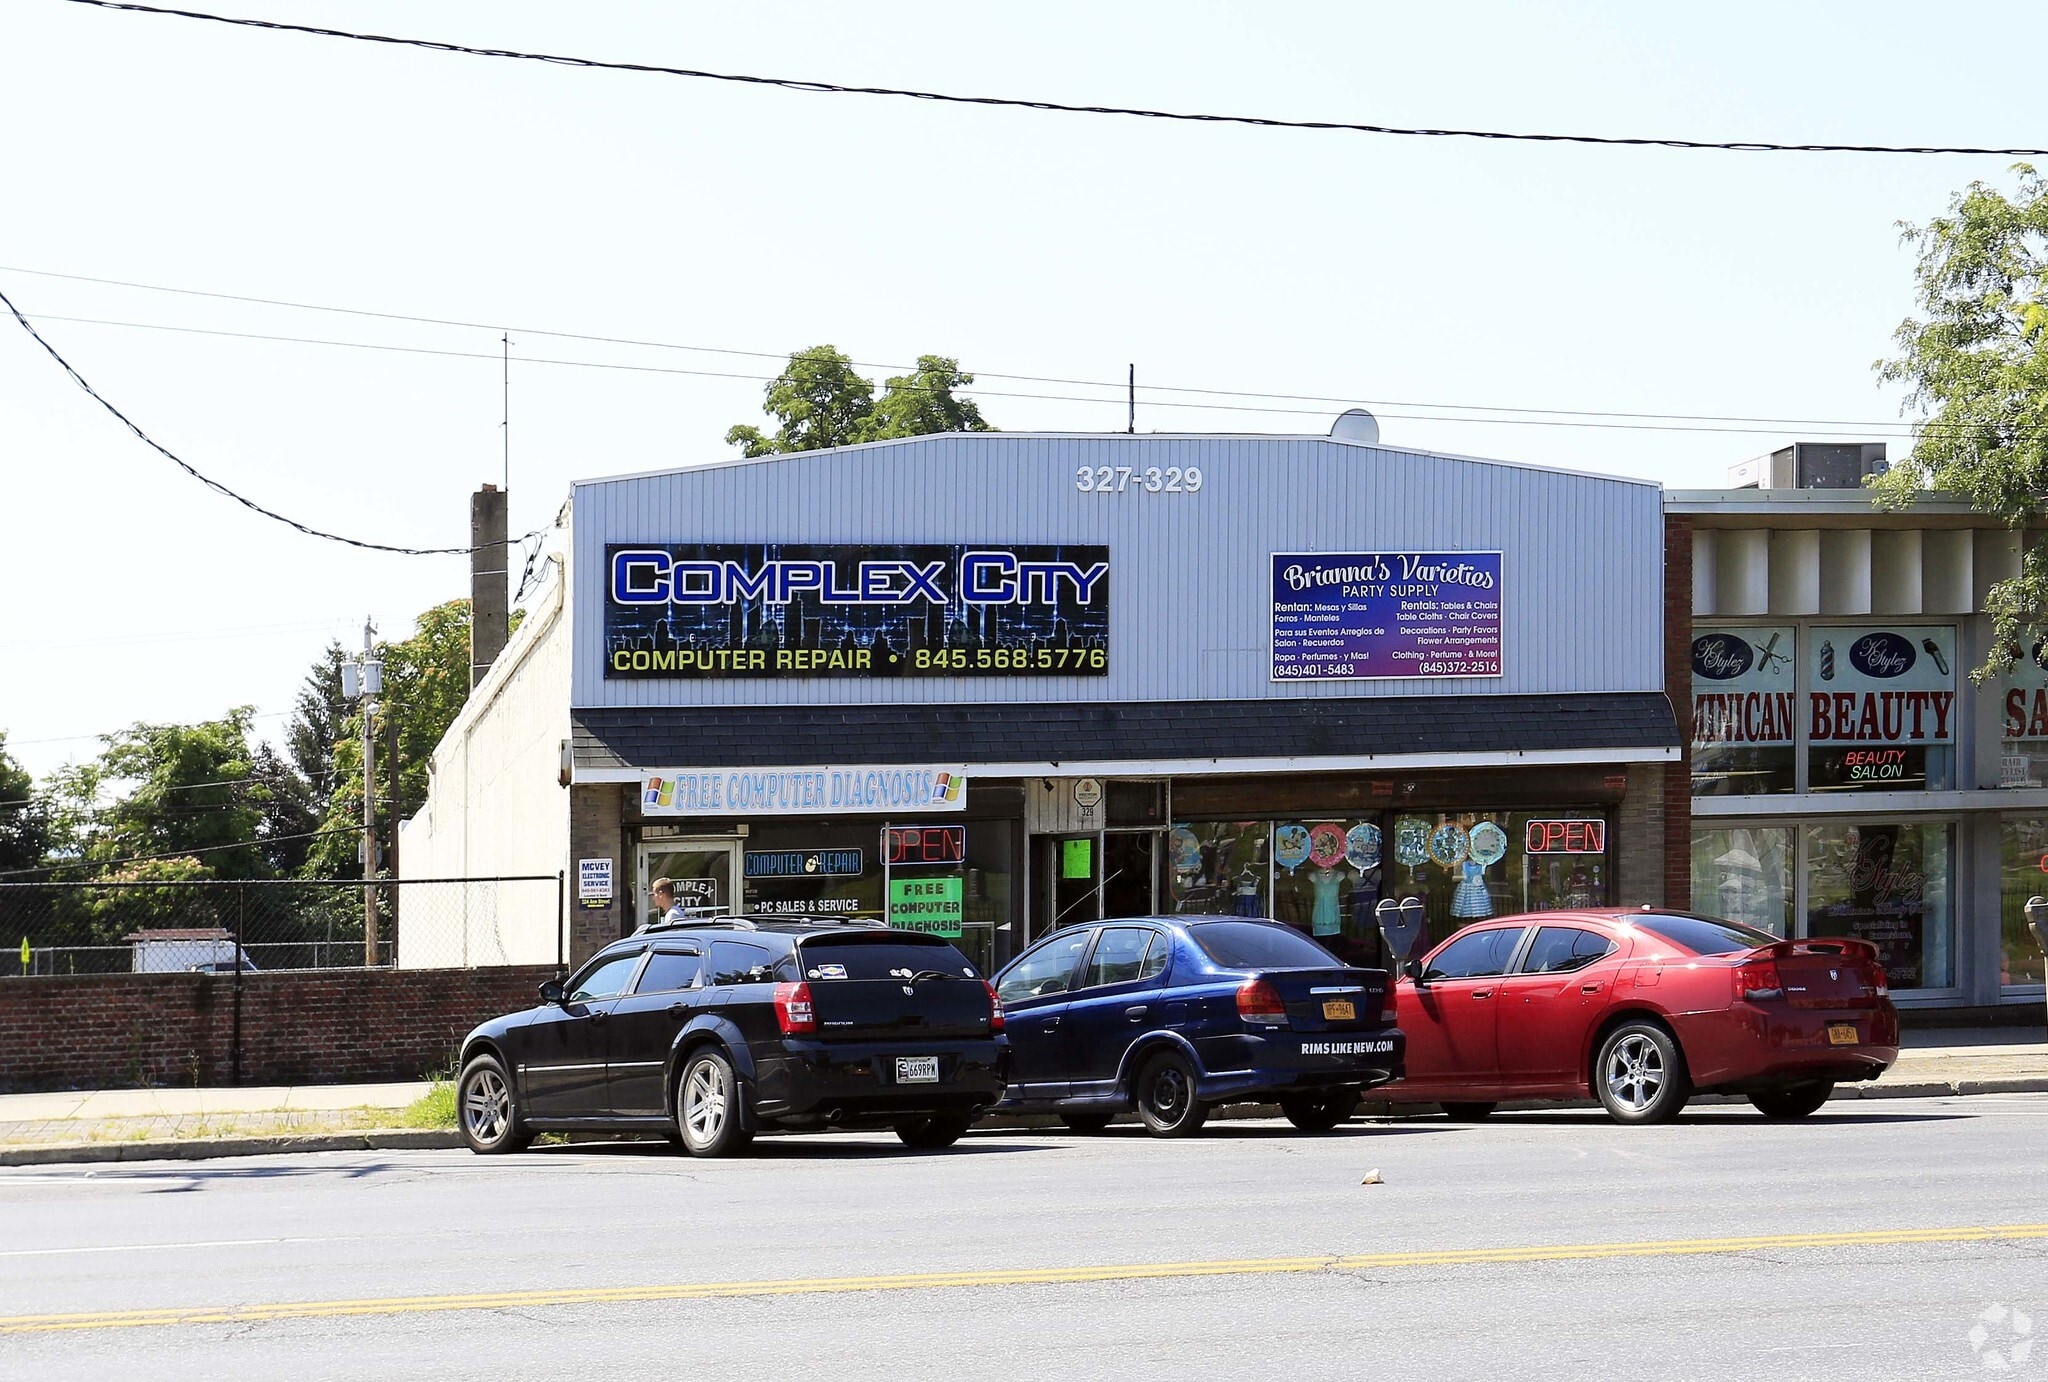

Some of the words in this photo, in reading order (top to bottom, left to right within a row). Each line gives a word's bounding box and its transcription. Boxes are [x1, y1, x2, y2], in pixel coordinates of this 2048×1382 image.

[1076, 466, 1202, 492] 327-329
[613, 550, 949, 605] COMPLEX
[960, 550, 1109, 605] CITY
[1283, 555, 1391, 591] Brianna's
[1397, 555, 1494, 589] Varieties
[1342, 585, 1384, 598] PARTY
[1390, 584, 1440, 597] SUPPLY
[1314, 604, 1340, 612] Mesas
[1341, 605, 1347, 613] y
[1347, 603, 1367, 611] Sillas
[1401, 601, 1439, 610] Rentals:
[1440, 601, 1465, 610] Tables
[1466, 601, 1472, 610] &
[1473, 601, 1498, 610] Chairs
[1304, 614, 1340, 622] Manteles
[1396, 613, 1418, 621] Table
[1418, 612, 1443, 621] Cloths
[1448, 612, 1470, 620] Chair
[1471, 612, 1498, 620] Covers
[1274, 628, 1293, 636] Para
[1308, 627, 1339, 636] Eventos
[1340, 627, 1373, 638] Arreglos
[1373, 627, 1385, 635] de
[1400, 626, 1447, 635] Decorations
[1452, 626, 1472, 636] Party
[1473, 625, 1498, 634] Favors
[1274, 638, 1297, 647] Salon
[1302, 638, 1345, 647] Recuerdos
[1417, 637, 1442, 645] Flower
[1443, 636, 1498, 646] Arrangements
[613, 650, 767, 671] COMPUTER
[776, 649, 872, 670] REPAIR
[915, 648, 1106, 670] 845.568.5776
[1274, 653, 1296, 663] Ropa
[1302, 652, 1338, 661] Perfumes
[1343, 653, 1349, 662] y
[1392, 651, 1425, 661] Clothing
[1430, 650, 1462, 659] Perfume
[1468, 650, 1474, 658] &
[1475, 650, 1498, 658] More!
[1867, 650, 1908, 674] Stylez
[1419, 661, 1498, 674] (845)372-2516
[1704, 650, 1745, 675] Stylez
[1274, 664, 1355, 677] (845)401-5483
[1809, 691, 1955, 740] BEAUTY
[1845, 751, 1905, 765] BEAUTY
[1850, 765, 1903, 778] SALON
[675, 773, 723, 810] FREE
[727, 771, 825, 809] COMPUTER
[831, 769, 933, 808] DIAGNOSIS
[1082, 807, 1094, 816] 329
[1528, 822, 1603, 852] OPEN
[884, 829, 962, 862] OPEN
[582, 862, 610, 871] MCVEY
[746, 854, 803, 875] COMPUTER
[819, 852, 860, 874] REPAIR
[904, 882, 944, 896] FREE
[673, 897, 702, 908] CITY
[760, 901, 775, 913] PC
[775, 901, 807, 913] SALES
[808, 900, 815, 912] &
[817, 899, 858, 912] SERVICE
[890, 901, 960, 914] COMPUTER
[891, 919, 961, 932] DIAGNOSIS
[1301, 1042, 1330, 1055] RIMS
[1331, 1042, 1352, 1054] LIKE
[1355, 1040, 1394, 1055] NEW.COM
